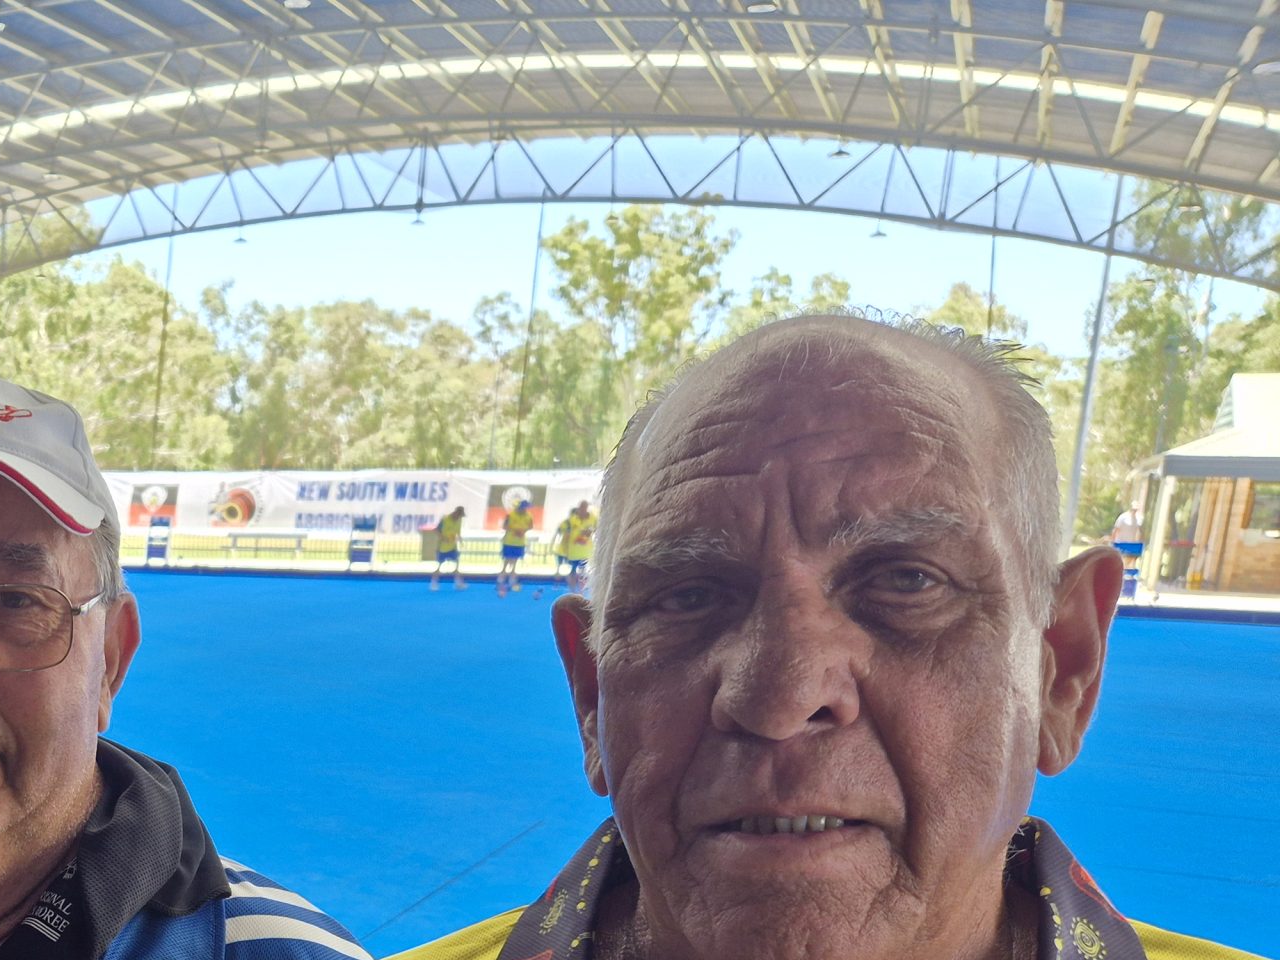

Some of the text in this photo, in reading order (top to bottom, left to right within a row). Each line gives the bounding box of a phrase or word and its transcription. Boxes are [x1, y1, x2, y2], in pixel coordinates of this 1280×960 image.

[297, 481, 448, 501] NEW SOUTH WALES
